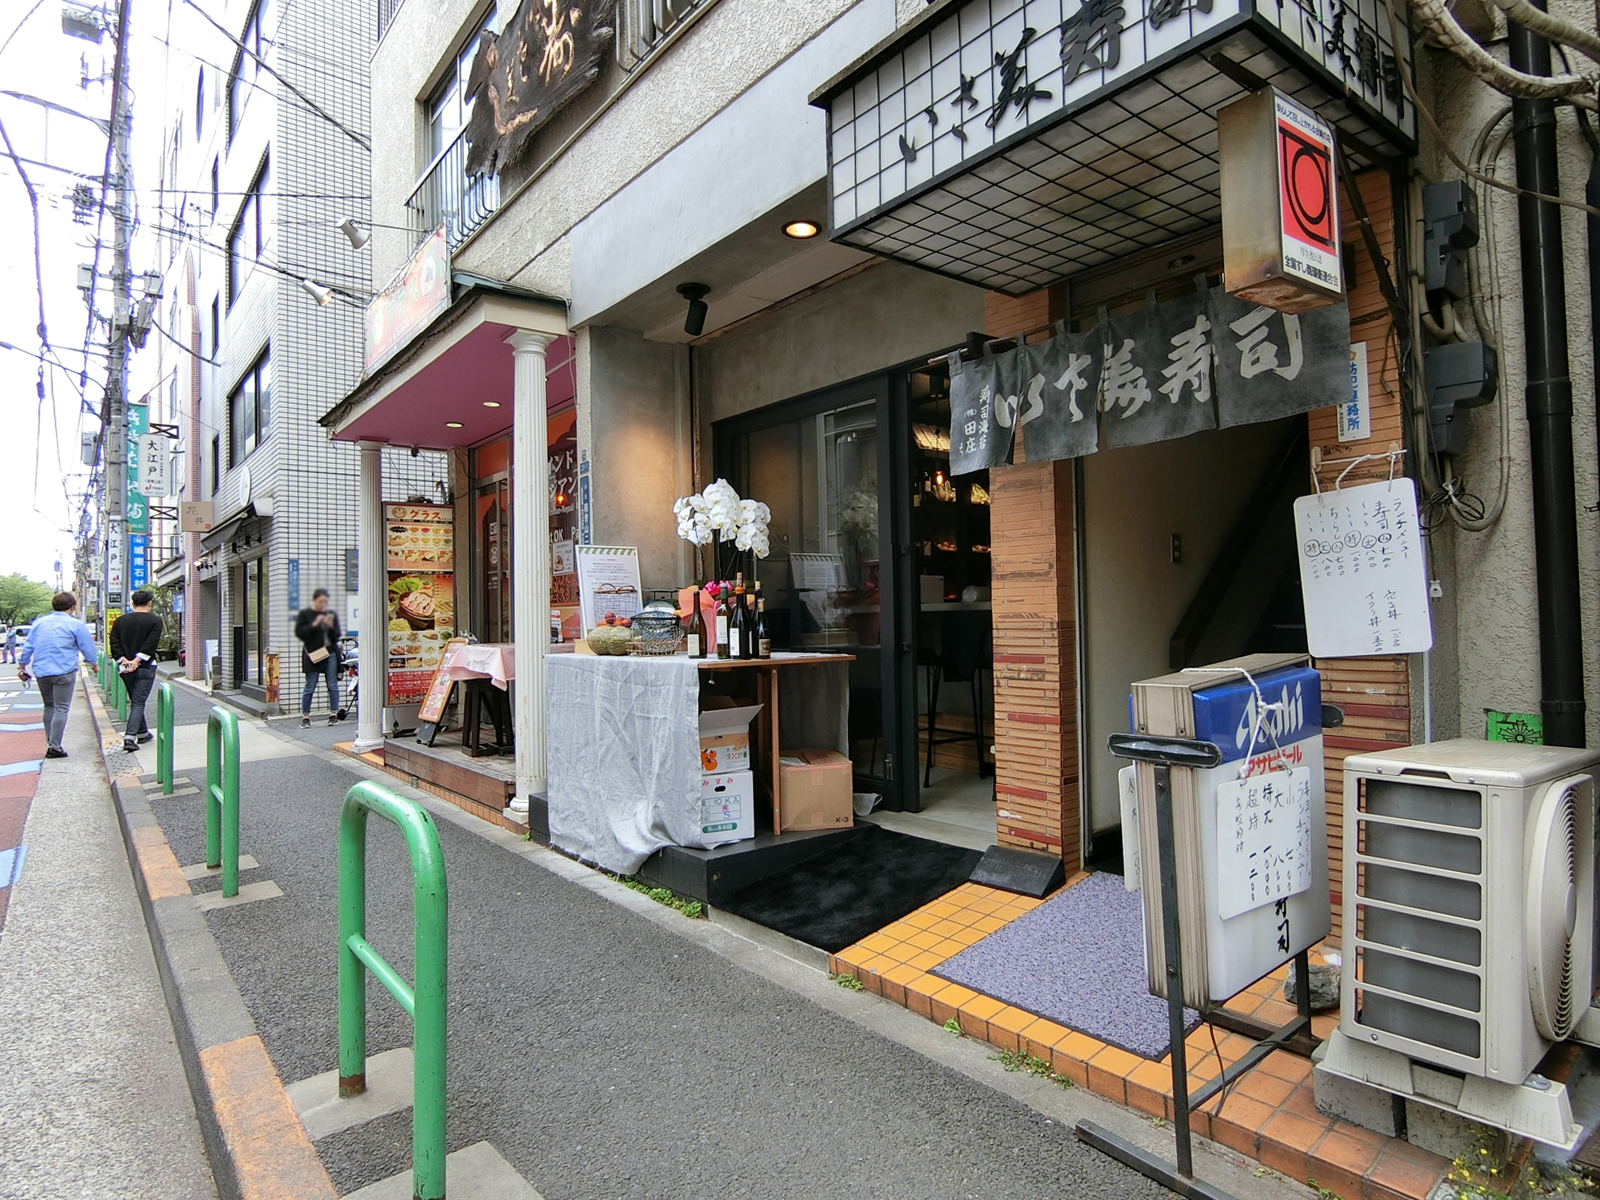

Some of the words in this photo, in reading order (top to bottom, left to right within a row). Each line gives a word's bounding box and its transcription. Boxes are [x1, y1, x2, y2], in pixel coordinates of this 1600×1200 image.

[979, 384, 991, 450] 寿司海苔
[147, 440, 159, 477] 大江戸
[410, 508, 441, 520] グラス
[110, 523, 119, 564] 大江戸
[1236, 680, 1304, 749] Asahi
